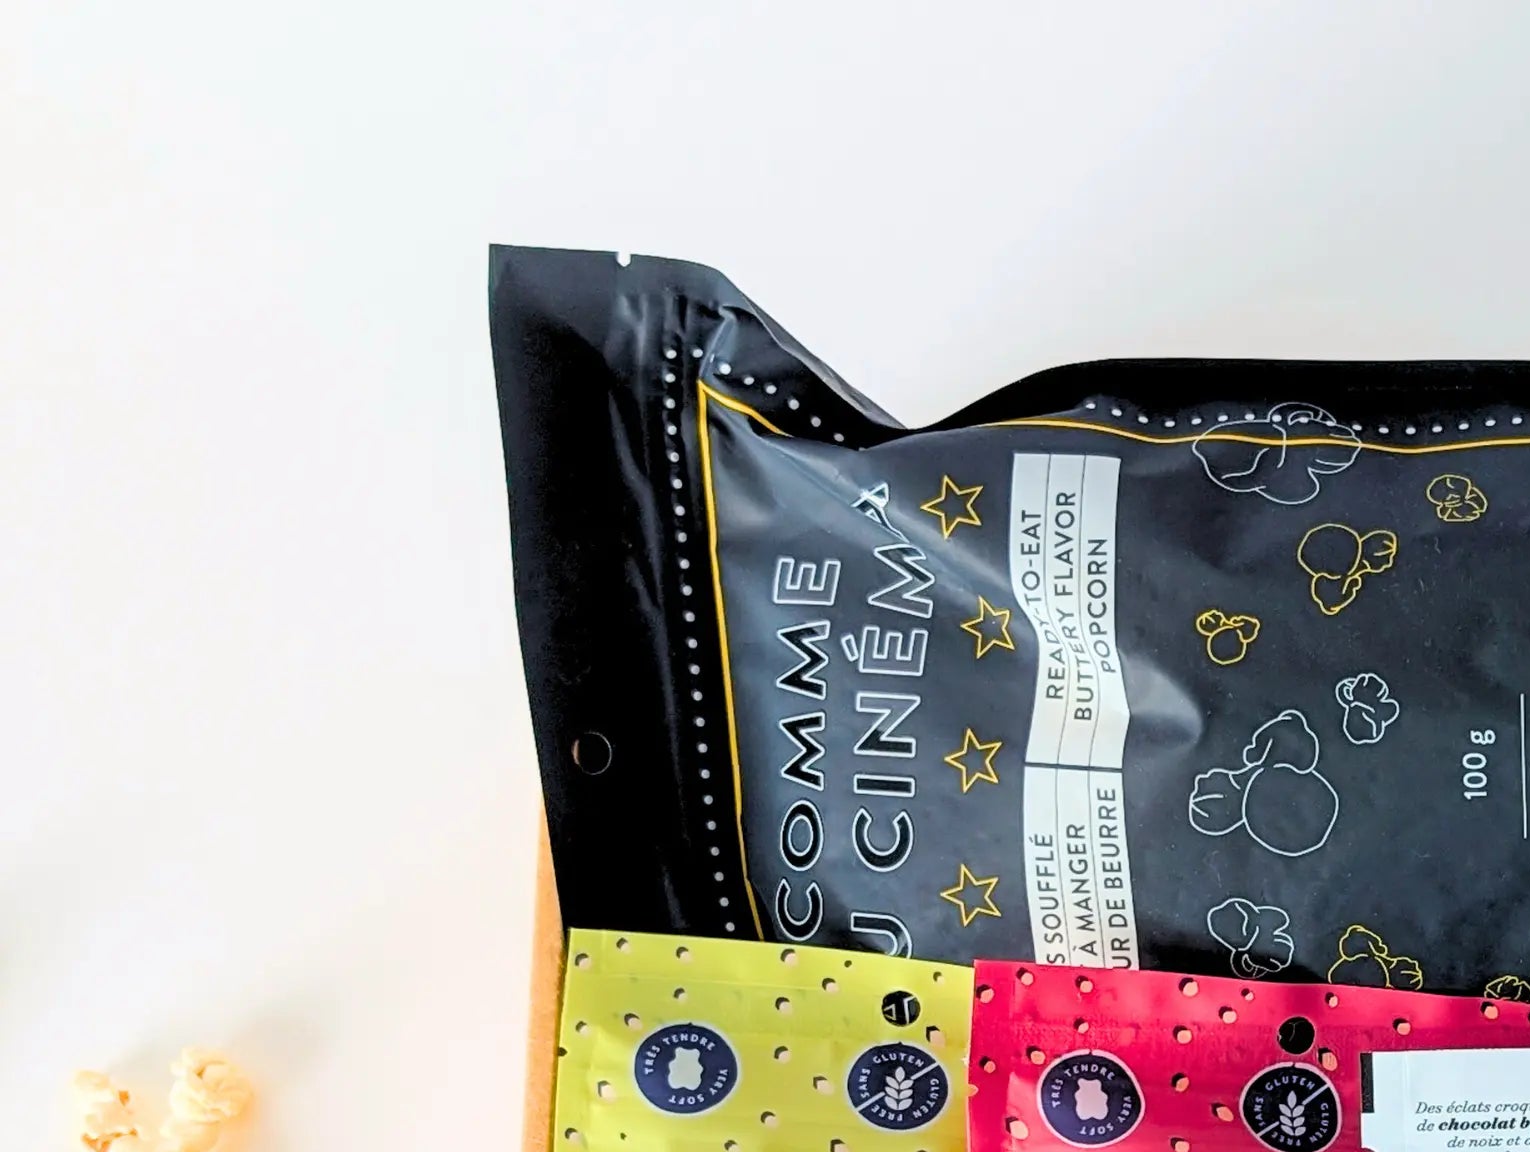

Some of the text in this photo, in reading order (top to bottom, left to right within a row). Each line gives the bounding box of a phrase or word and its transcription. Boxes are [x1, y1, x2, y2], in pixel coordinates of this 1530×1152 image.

[1020, 510, 1067, 700] READY-TO-EAT
[1054, 492, 1094, 721] BUTTERY FLAVOR
[1087, 539, 1116, 673] POPCORN
[773, 558, 841, 941] COMME
[1462, 729, 1496, 800] 100 g
[1097, 788, 1128, 928] DE BEURRE
[1028, 834, 1064, 944] SOUFFLÉ
[1066, 824, 1098, 956] À MANGER
[662, 1033, 716, 1051] TENDRE
[858, 1052, 925, 1099] SANS GLUTEN
[1064, 1064, 1115, 1080] TENDRE
[668, 1093, 705, 1105] SOFT
[870, 1078, 940, 1122] GLUTEN FREE
[1253, 1075, 1316, 1127] SANS GLUTEN
[1415, 1101, 1443, 1114] Des
[1446, 1100, 1491, 1114] éclats
[1079, 1122, 1114, 1135] SOFT
[1416, 1119, 1435, 1132] de
[1438, 1117, 1517, 1131] chocolat
[1447, 1136, 1465, 1148] de
[1468, 1135, 1503, 1147] noix
[1506, 1135, 1520, 1146] et
